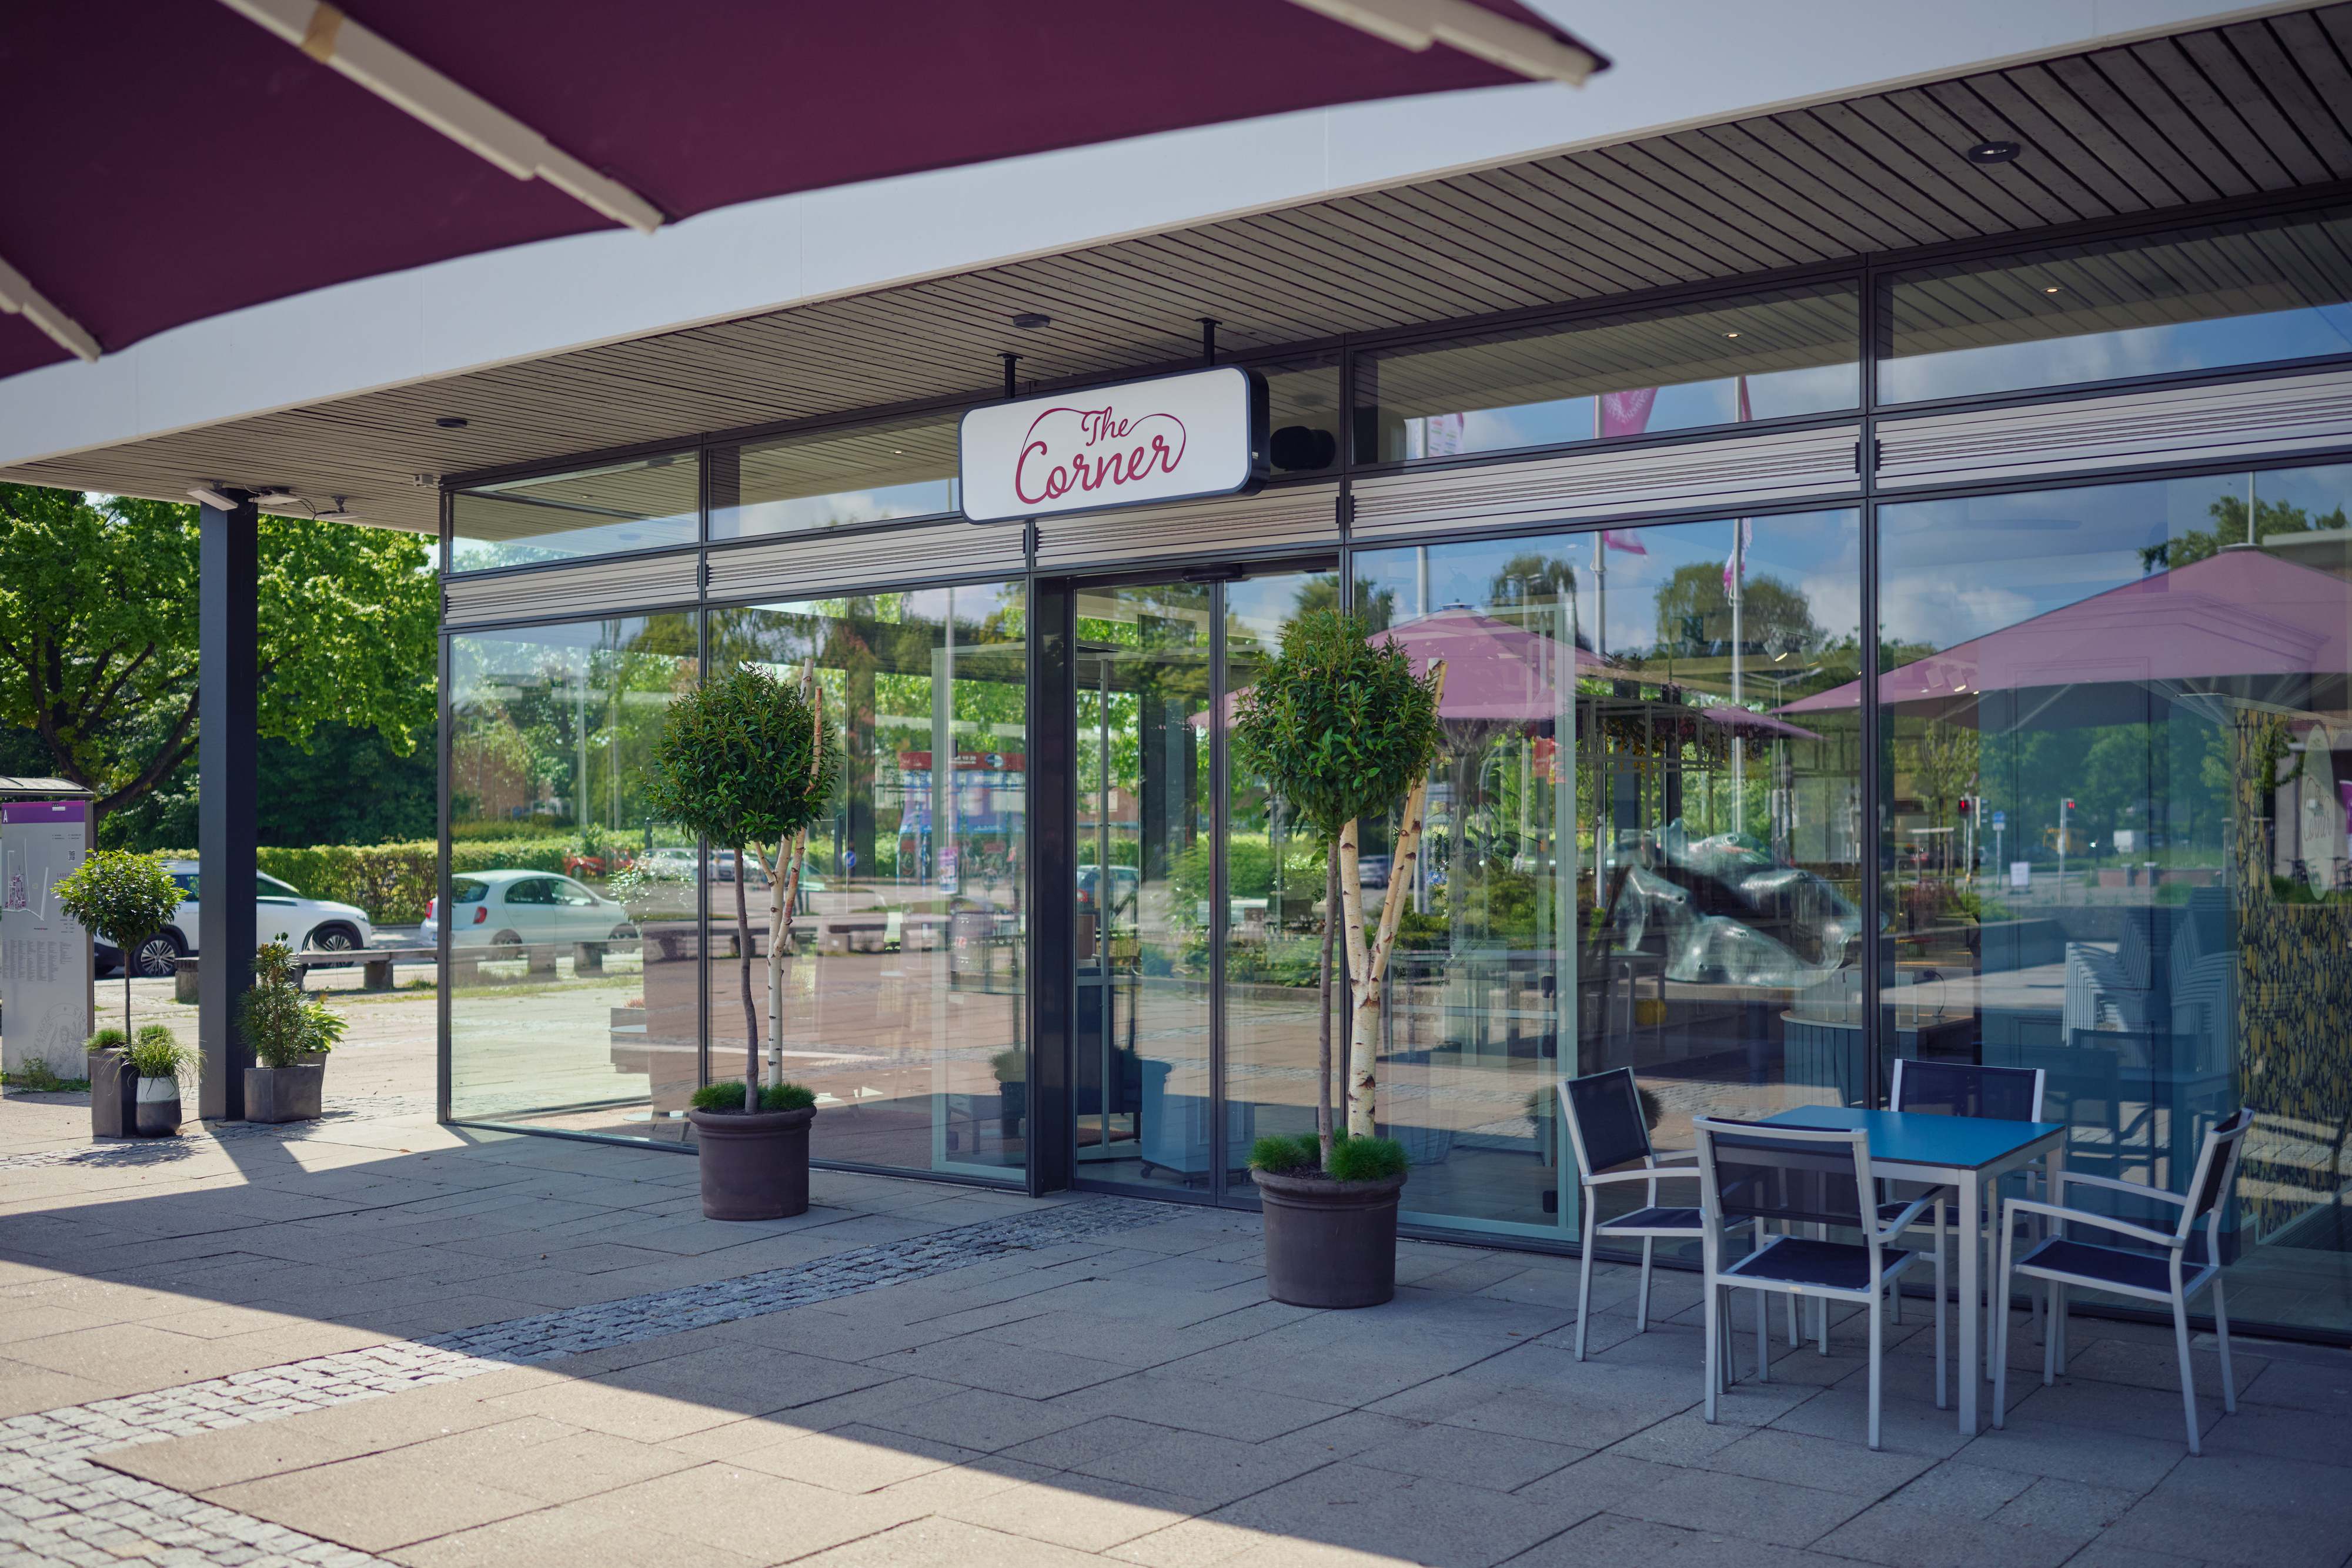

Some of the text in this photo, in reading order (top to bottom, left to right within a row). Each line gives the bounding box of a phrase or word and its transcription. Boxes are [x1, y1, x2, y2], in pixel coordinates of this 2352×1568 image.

[1081, 406, 1130, 446] The
[1015, 434, 1181, 504] Corner
[3, 809, 8, 823] A
